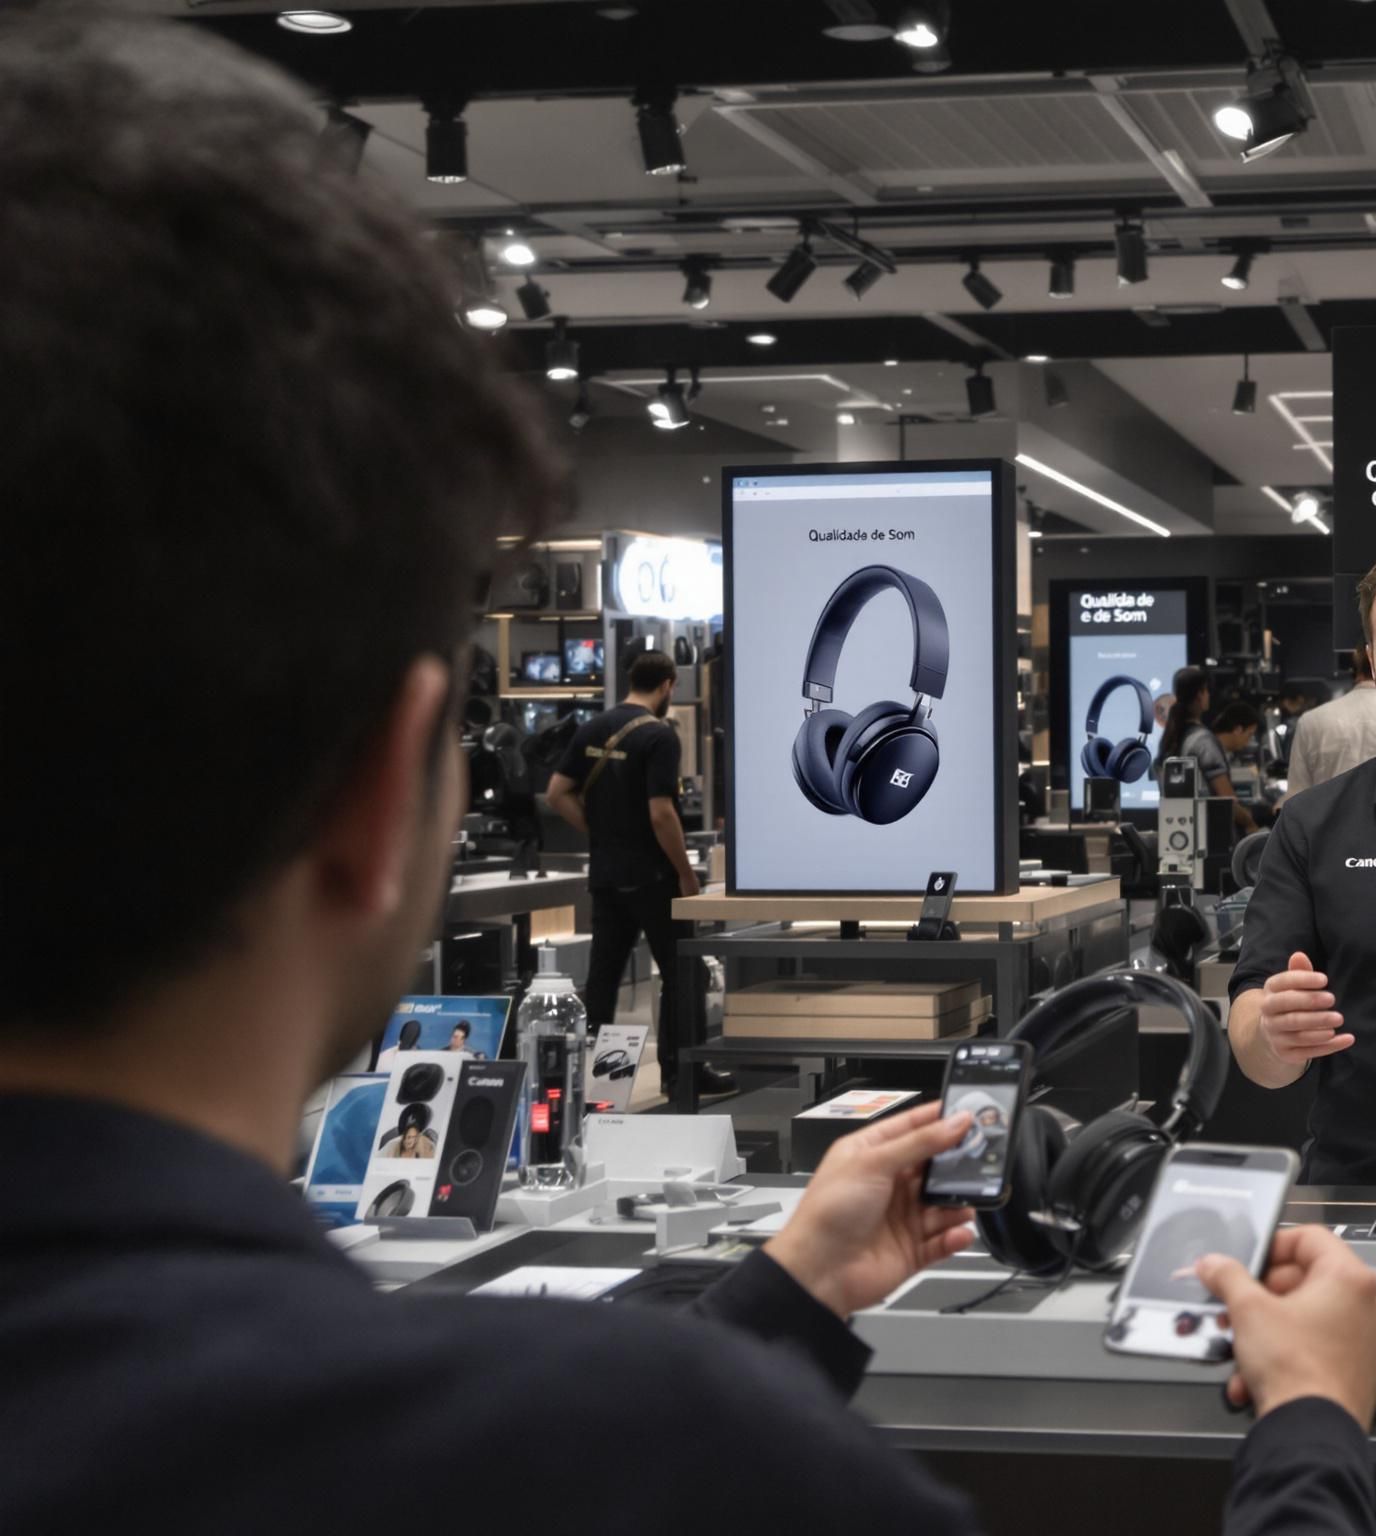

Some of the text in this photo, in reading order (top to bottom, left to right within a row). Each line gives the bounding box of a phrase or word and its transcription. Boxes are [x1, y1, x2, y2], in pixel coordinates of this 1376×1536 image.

[808, 528, 916, 543] Qualidade de Som
[1113, 608, 1147, 623] Som
